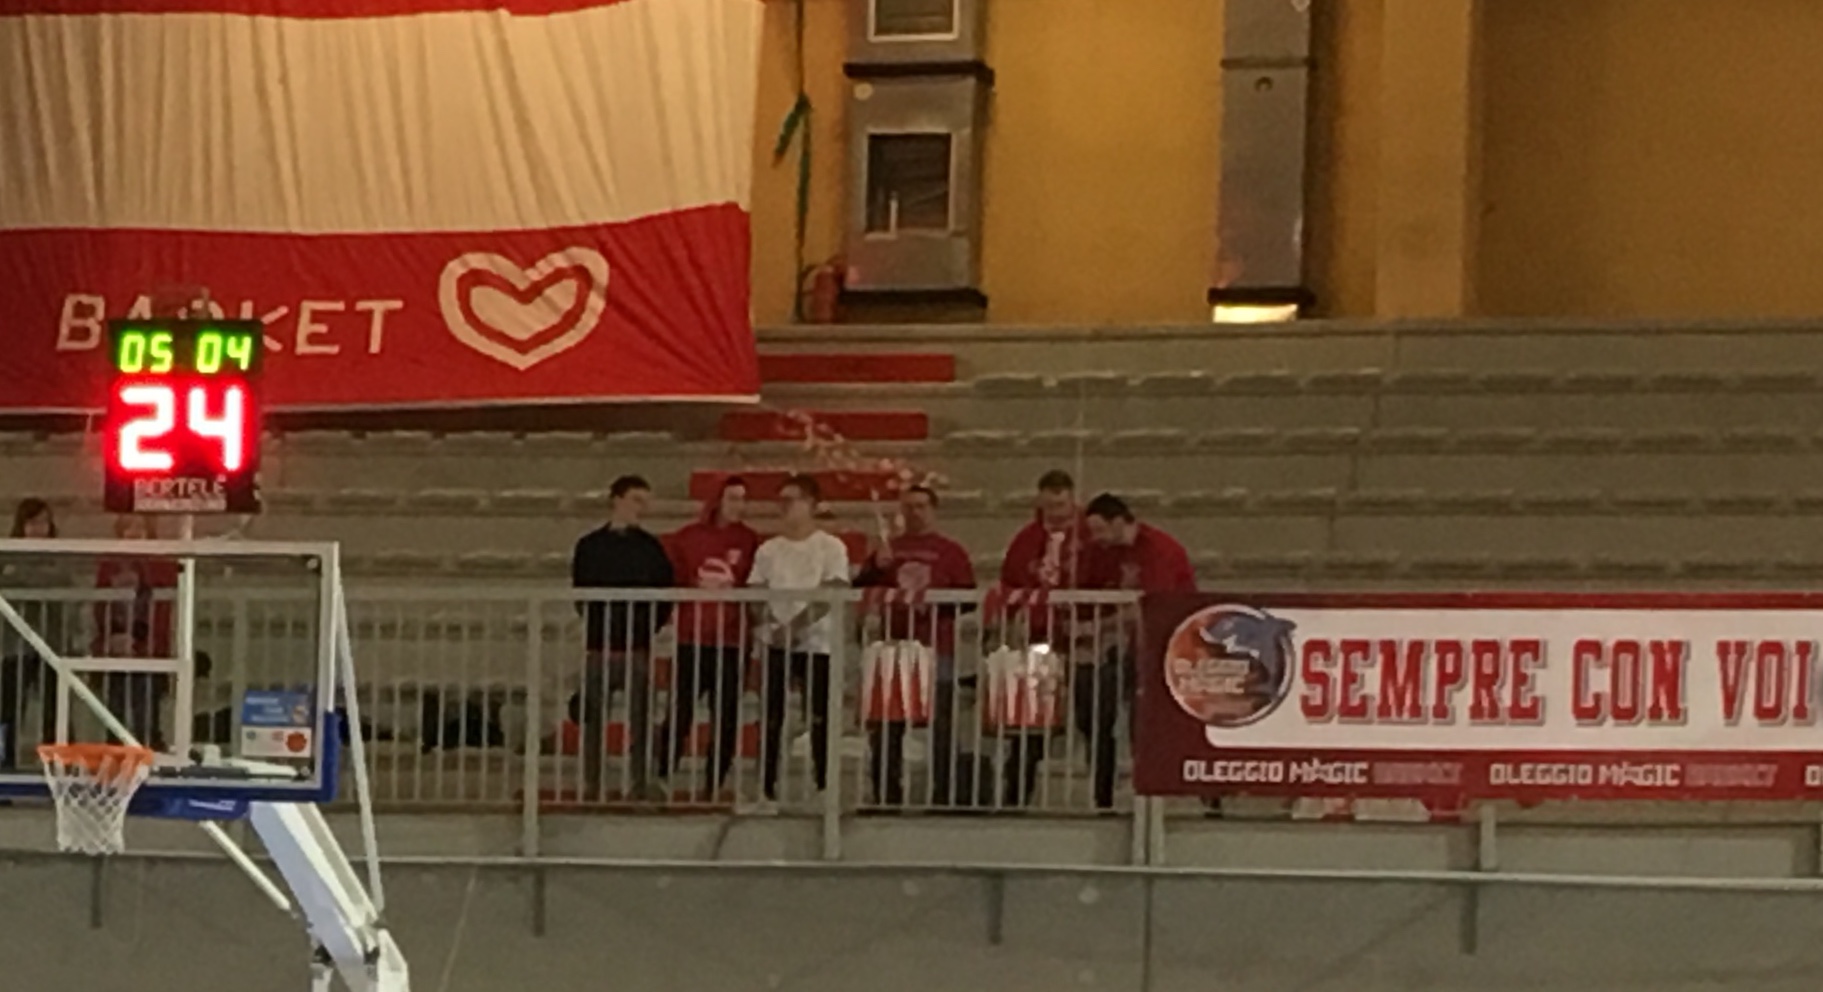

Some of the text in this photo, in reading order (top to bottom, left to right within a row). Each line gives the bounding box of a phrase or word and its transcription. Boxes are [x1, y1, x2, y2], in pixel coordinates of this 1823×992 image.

[118, 384, 243, 472] 24
[1300, 638, 1817, 726] SEMPRE CON VOI
[1183, 760, 1284, 783] OLEGGIO
[1489, 763, 1593, 786] OLEGGIO
